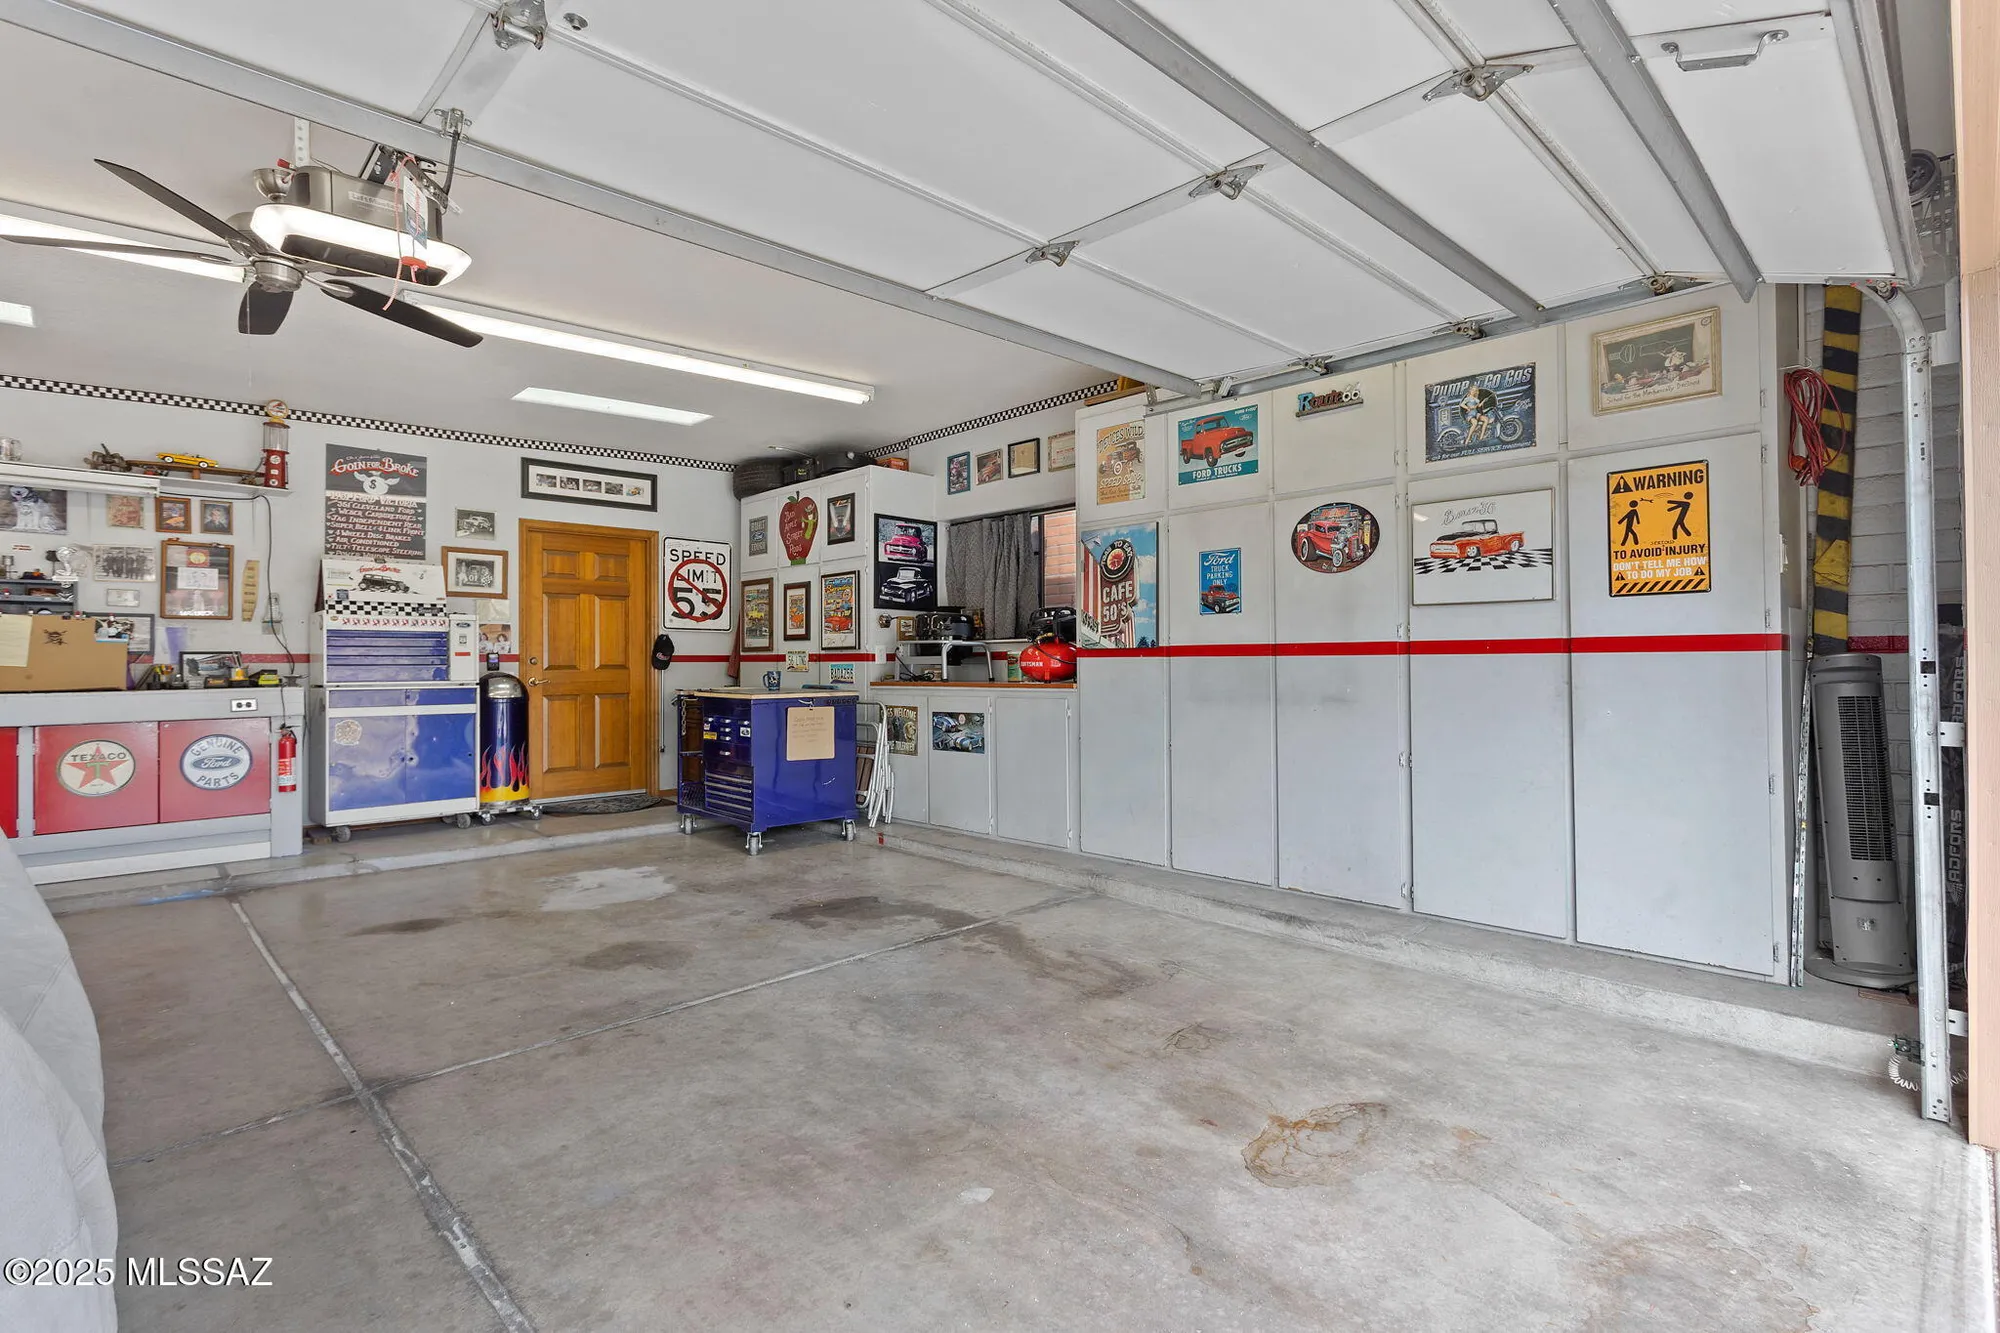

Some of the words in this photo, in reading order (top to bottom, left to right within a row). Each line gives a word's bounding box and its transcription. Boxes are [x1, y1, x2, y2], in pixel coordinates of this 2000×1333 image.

[1342, 381, 1361, 402] 66
[1431, 381, 1470, 399] PUMP
[1503, 367, 1533, 387] GAS
[1192, 469, 1212, 479] FORD
[1213, 463, 1242, 475] TRUCKS
[1633, 469, 1704, 491] WARNING
[669, 548, 727, 566] SPEED
[1203, 552, 1236, 566] Ford
[1613, 550, 1627, 559] TO
[1630, 547, 1662, 559] AVOID
[1665, 544, 1706, 556] INJURY
[1613, 561, 1640, 571] DON'T
[1642, 560, 1663, 569] TELL
[1666, 558, 1681, 567] ME
[1683, 557, 1707, 566] HOW
[1206, 571, 1233, 580] PARKING
[1626, 570, 1639, 579] TO
[1641, 569, 1654, 578] DO
[1656, 568, 1671, 577] MY
[1673, 567, 1692, 577] JOB
[1102, 580, 1133, 603] CAFE
[671, 586, 724, 621] 55
[1102, 602, 1128, 622] 50'S
[191, 736, 244, 757] GENUINE
[71, 752, 126, 762] TEXACO
[201, 756, 233, 769] Ford
[196, 772, 240, 786] PARTS
[1948, 809, 1962, 882] ADFORS
